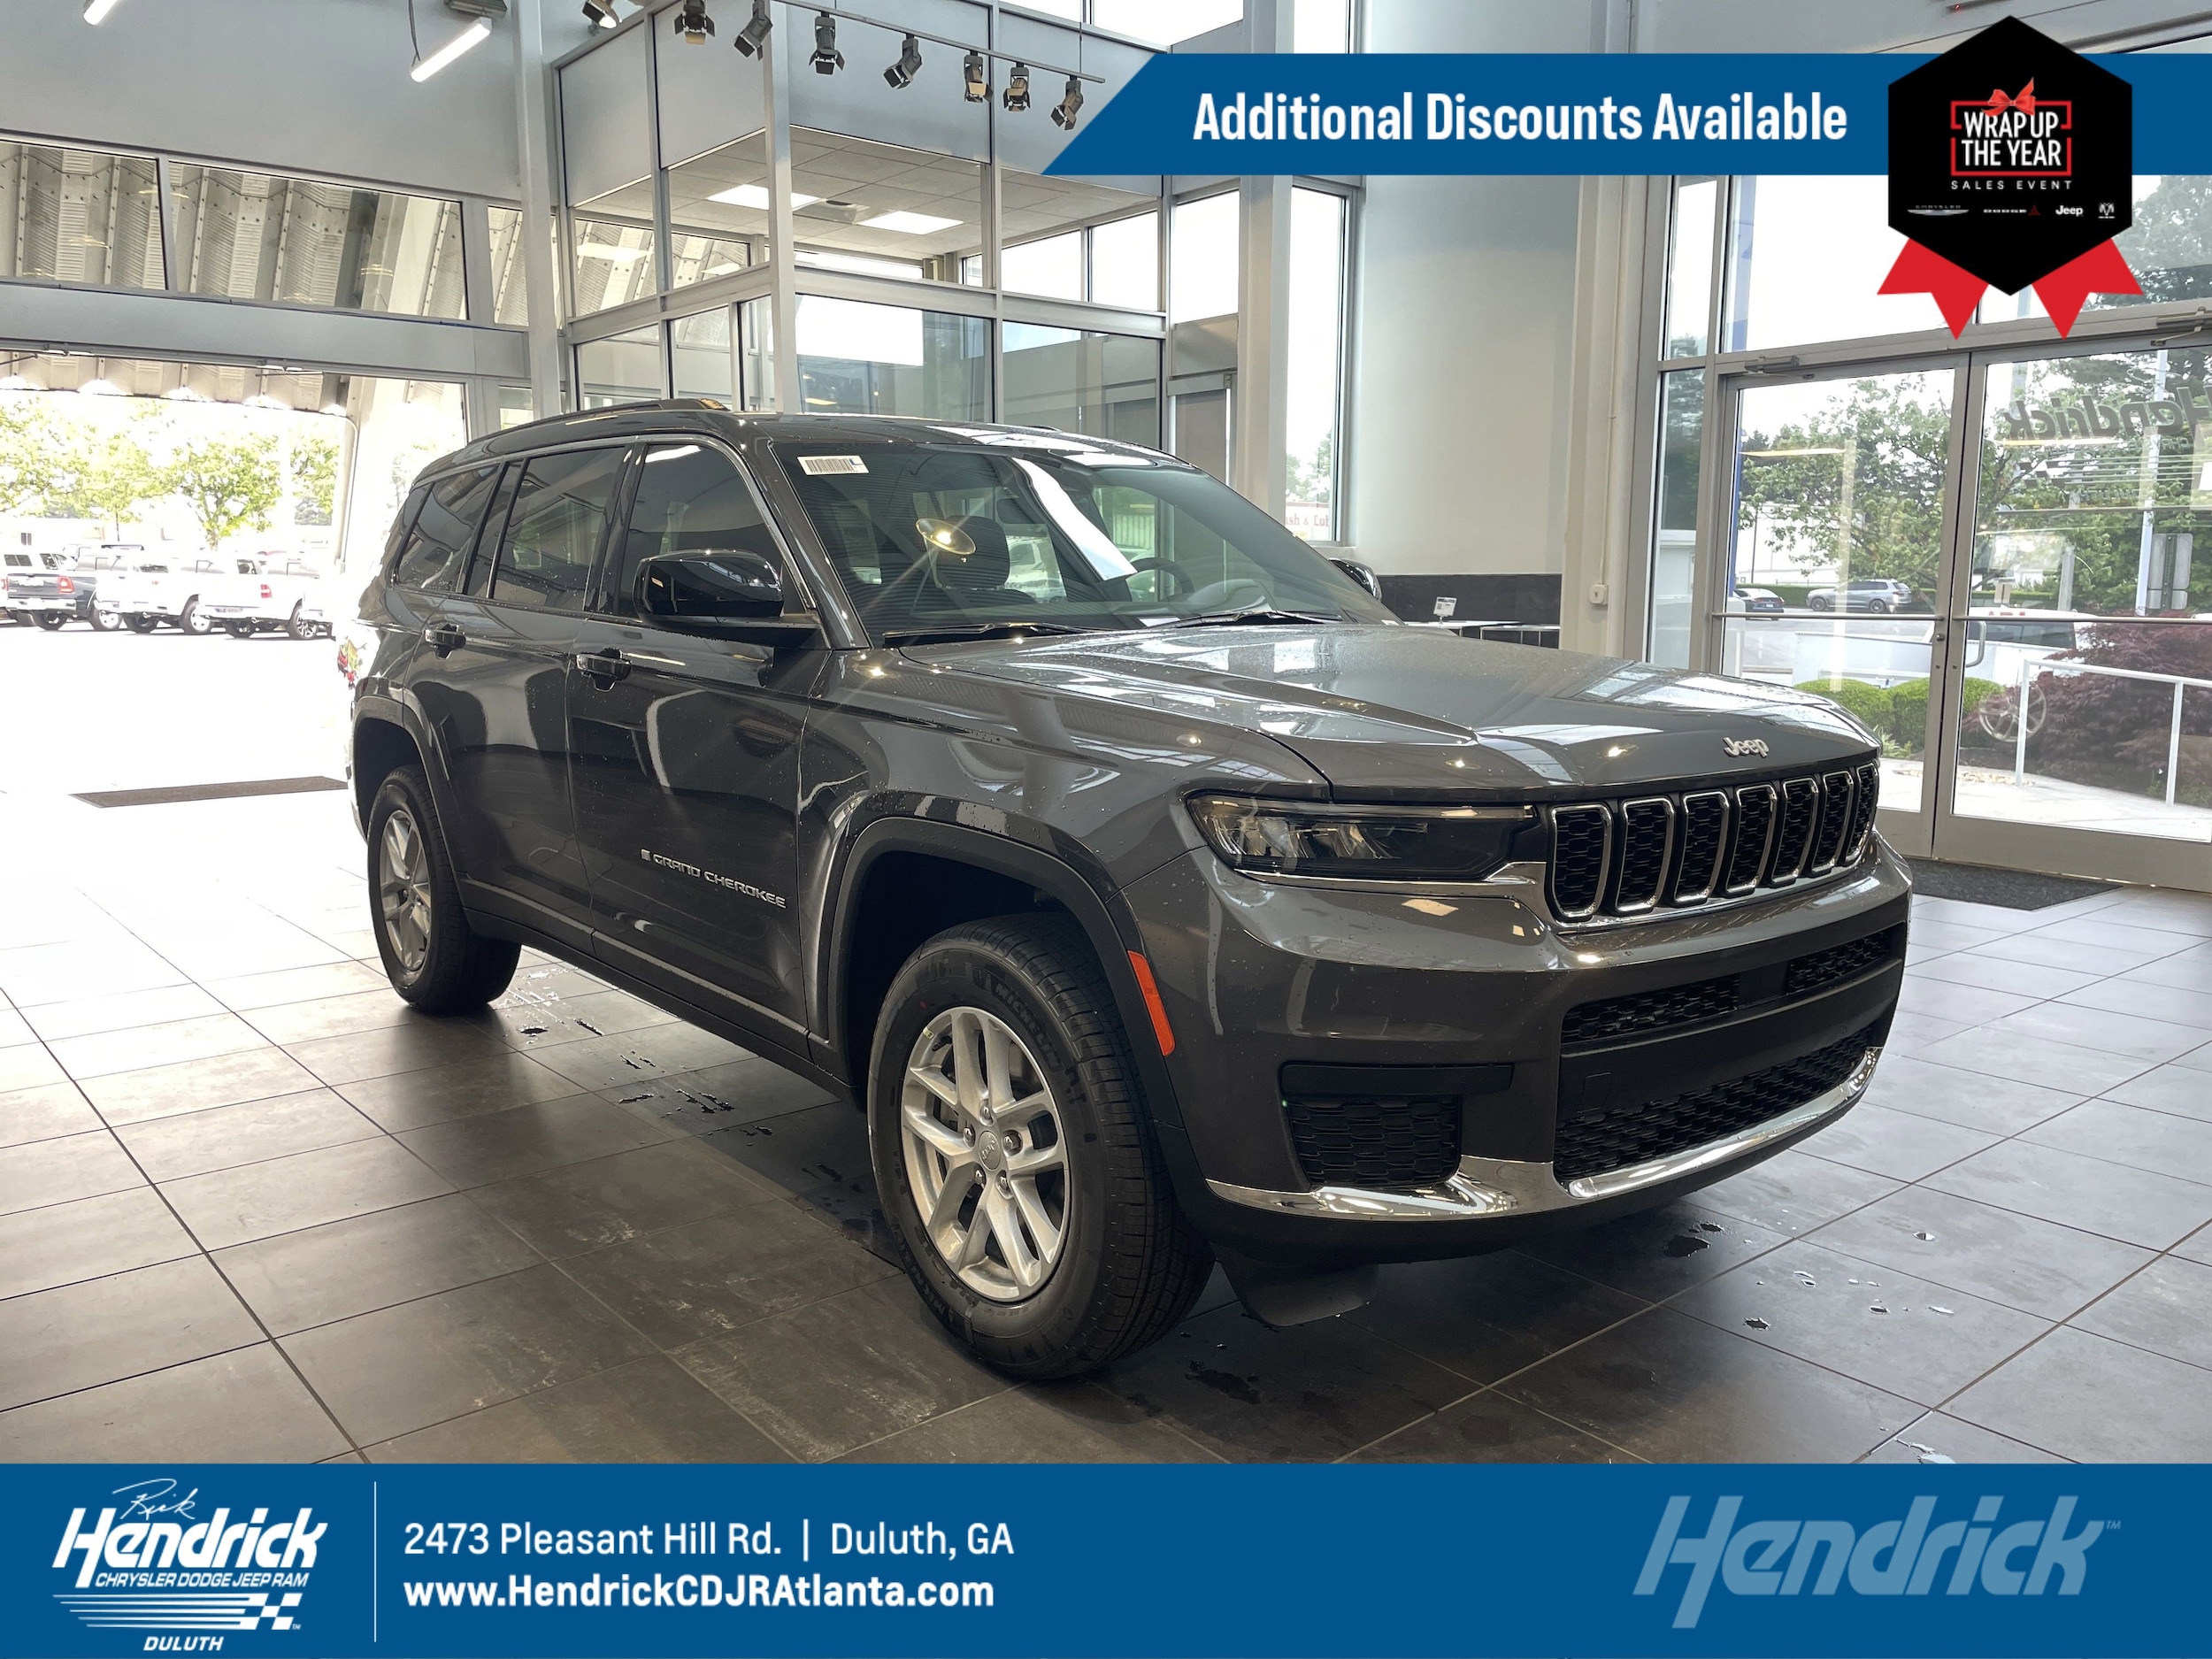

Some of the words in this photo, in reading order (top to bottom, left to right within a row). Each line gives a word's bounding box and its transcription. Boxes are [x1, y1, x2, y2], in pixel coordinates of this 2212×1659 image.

[1722, 736, 1770, 758] Jeep
[652, 853, 701, 879] GRAND
[703, 871, 787, 909] CHEROKEE
